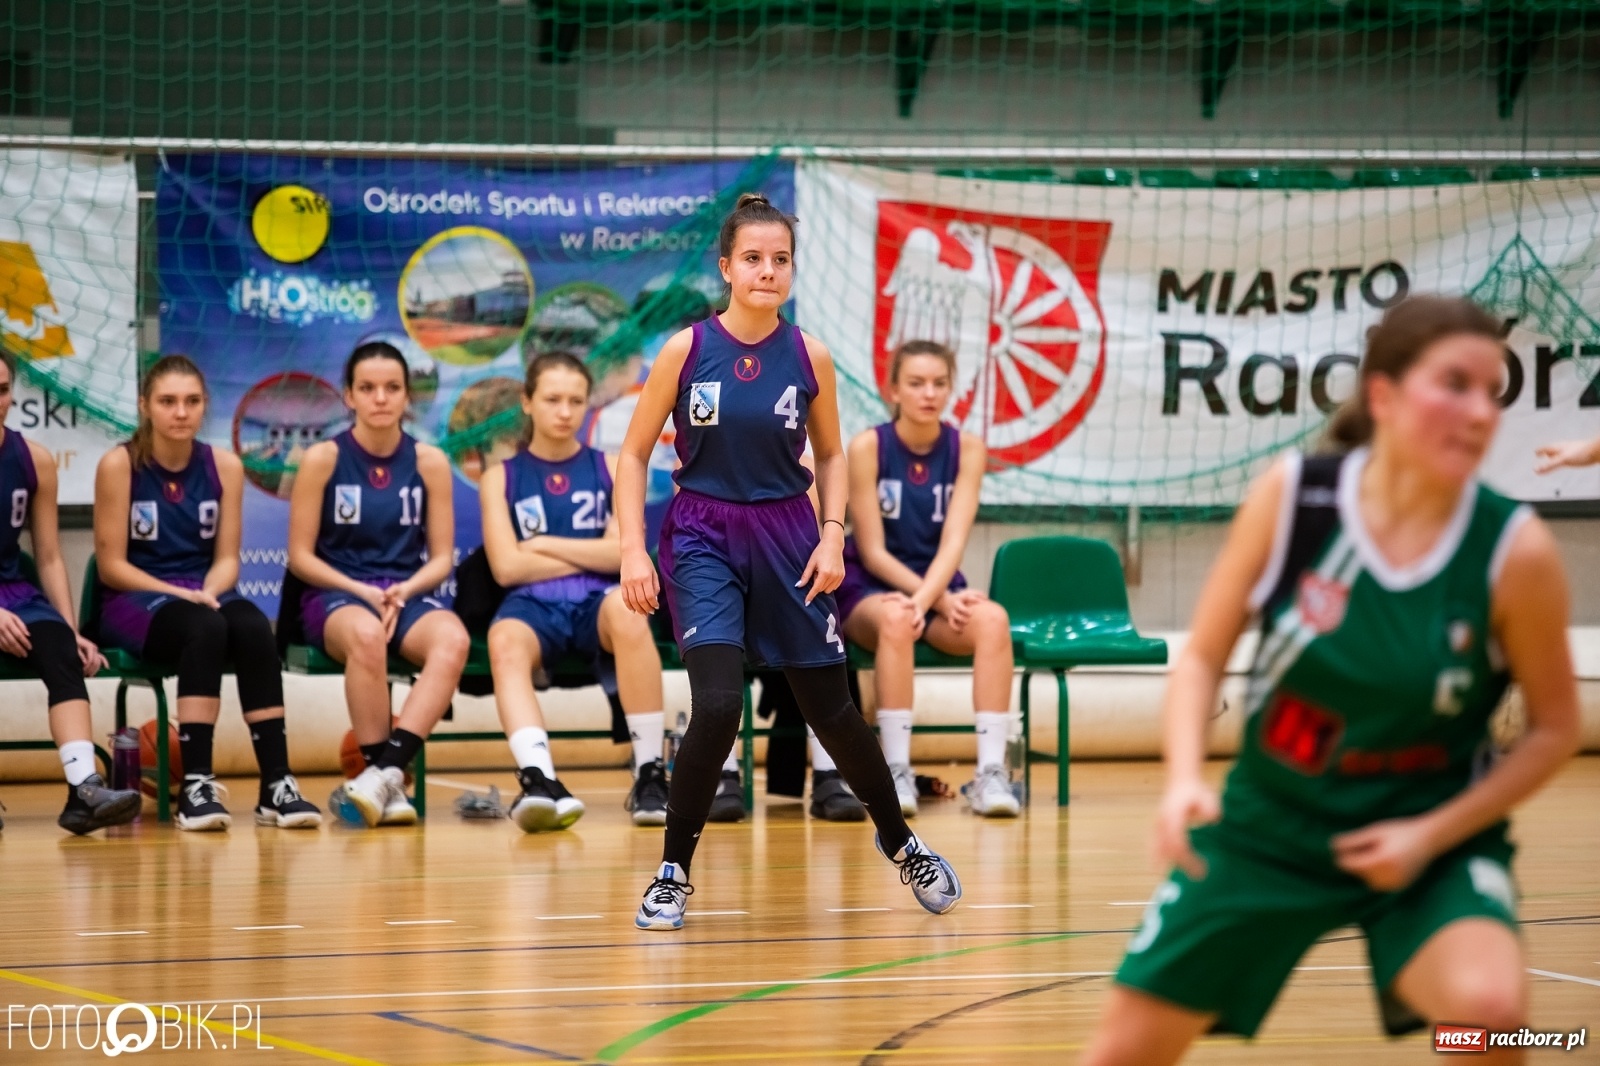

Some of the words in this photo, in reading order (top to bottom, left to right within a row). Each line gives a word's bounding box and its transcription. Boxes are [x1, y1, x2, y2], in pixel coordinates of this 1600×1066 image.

[364, 187, 481, 214] Ośrodek
[488, 191, 576, 219] Sportu
[584, 191, 592, 216] i
[598, 190, 718, 217] Rekreac
[560, 231, 586, 250] w
[1157, 260, 1409, 316] MIASTO
[774, 385, 799, 430] 4
[10, 488, 28, 528] 8
[198, 500, 219, 539] 9
[399, 486, 424, 526] 11
[825, 613, 845, 654] 4
